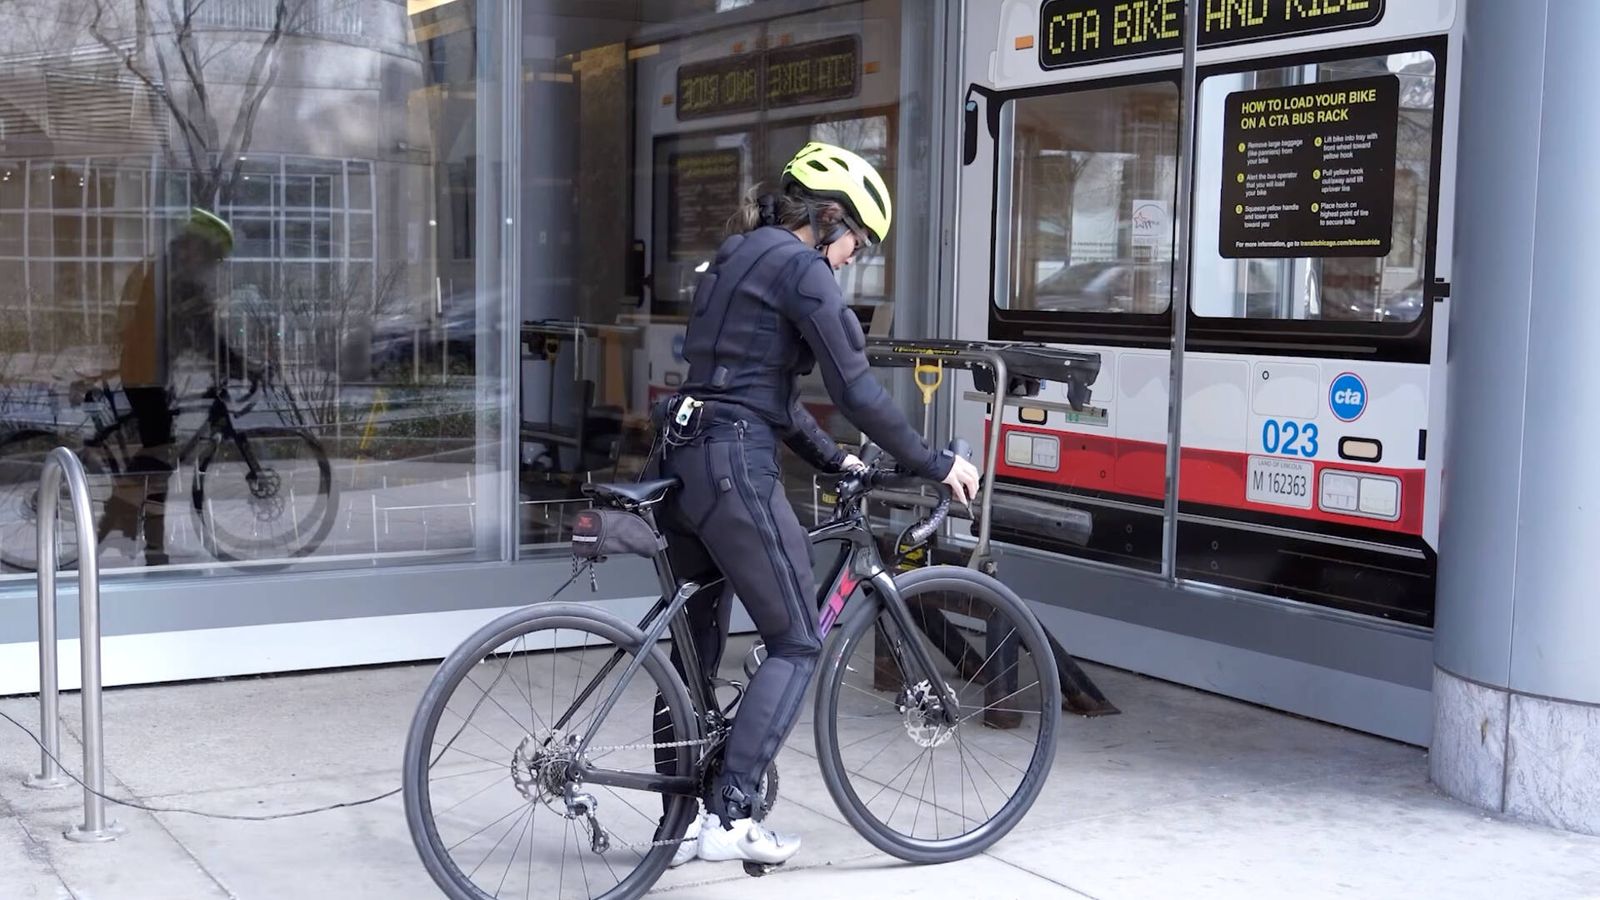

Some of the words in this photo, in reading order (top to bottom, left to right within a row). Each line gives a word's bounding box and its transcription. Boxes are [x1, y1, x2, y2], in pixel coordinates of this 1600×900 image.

[1049, 9, 1100, 54] CTA
[1113, 0, 1180, 46] BIKE
[1242, 101, 1266, 114] HOW
[1267, 98, 1282, 111] TO
[1284, 96, 1314, 110] LOAD
[1315, 92, 1346, 106] YOUR
[1349, 89, 1376, 103] BIKE
[1241, 117, 1256, 129] ON
[1258, 116, 1266, 128] A
[1269, 114, 1290, 126] CTA
[1292, 112, 1314, 125] BUS
[1318, 108, 1348, 122] RACK
[1323, 153, 1340, 161] yellow
[1333, 168, 1350, 177] yellow
[1320, 211, 1339, 219] highest
[1334, 388, 1362, 406] cta
[1262, 420, 1319, 458] 023
[1253, 470, 1264, 492] M
[1268, 472, 1307, 497] 162363
